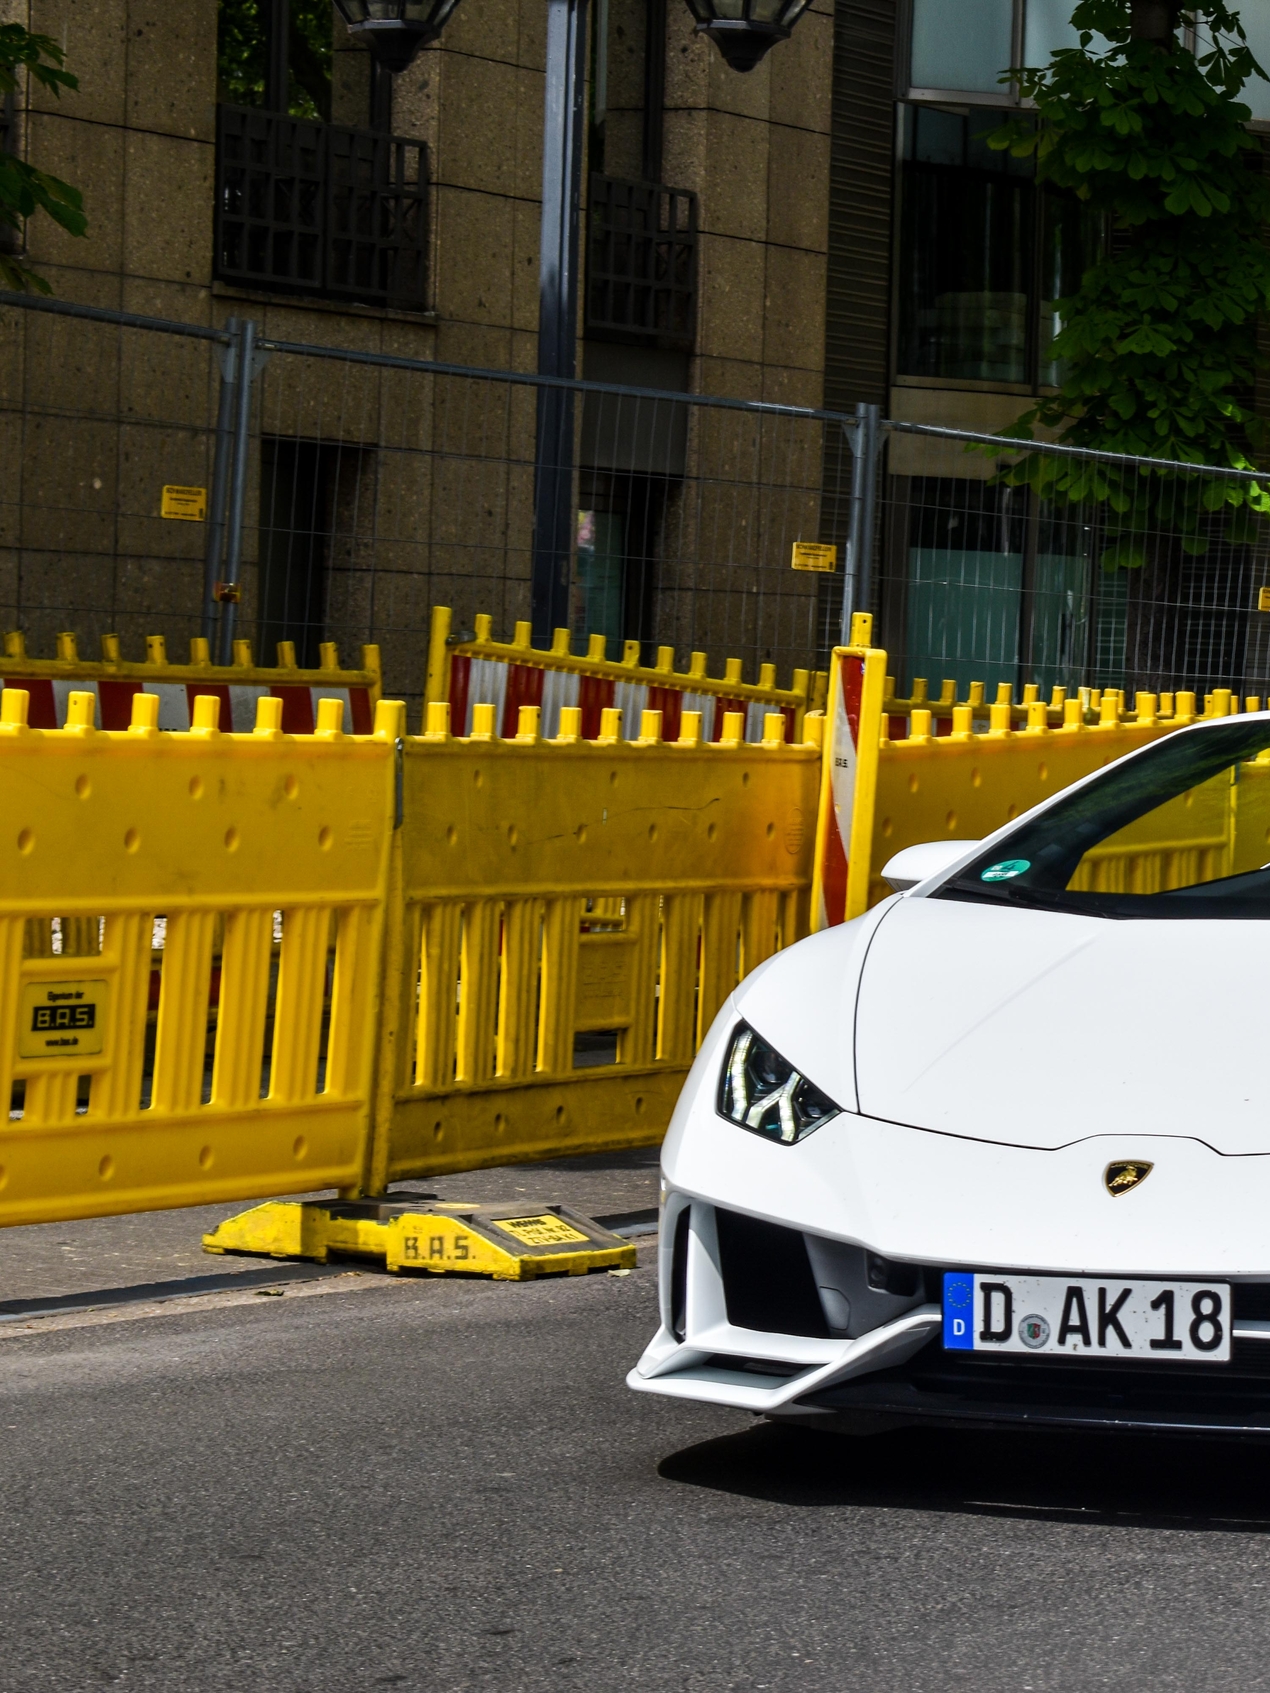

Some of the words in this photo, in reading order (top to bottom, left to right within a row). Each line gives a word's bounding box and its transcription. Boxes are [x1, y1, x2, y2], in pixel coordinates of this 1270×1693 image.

[37, 1008, 93, 1027] B.A.S.
[404, 1235, 476, 1260] B.A.S.
[953, 1319, 966, 1336] D
[979, 1281, 1013, 1343] D
[1057, 1286, 1133, 1349] AK
[1149, 1289, 1223, 1352] 18
